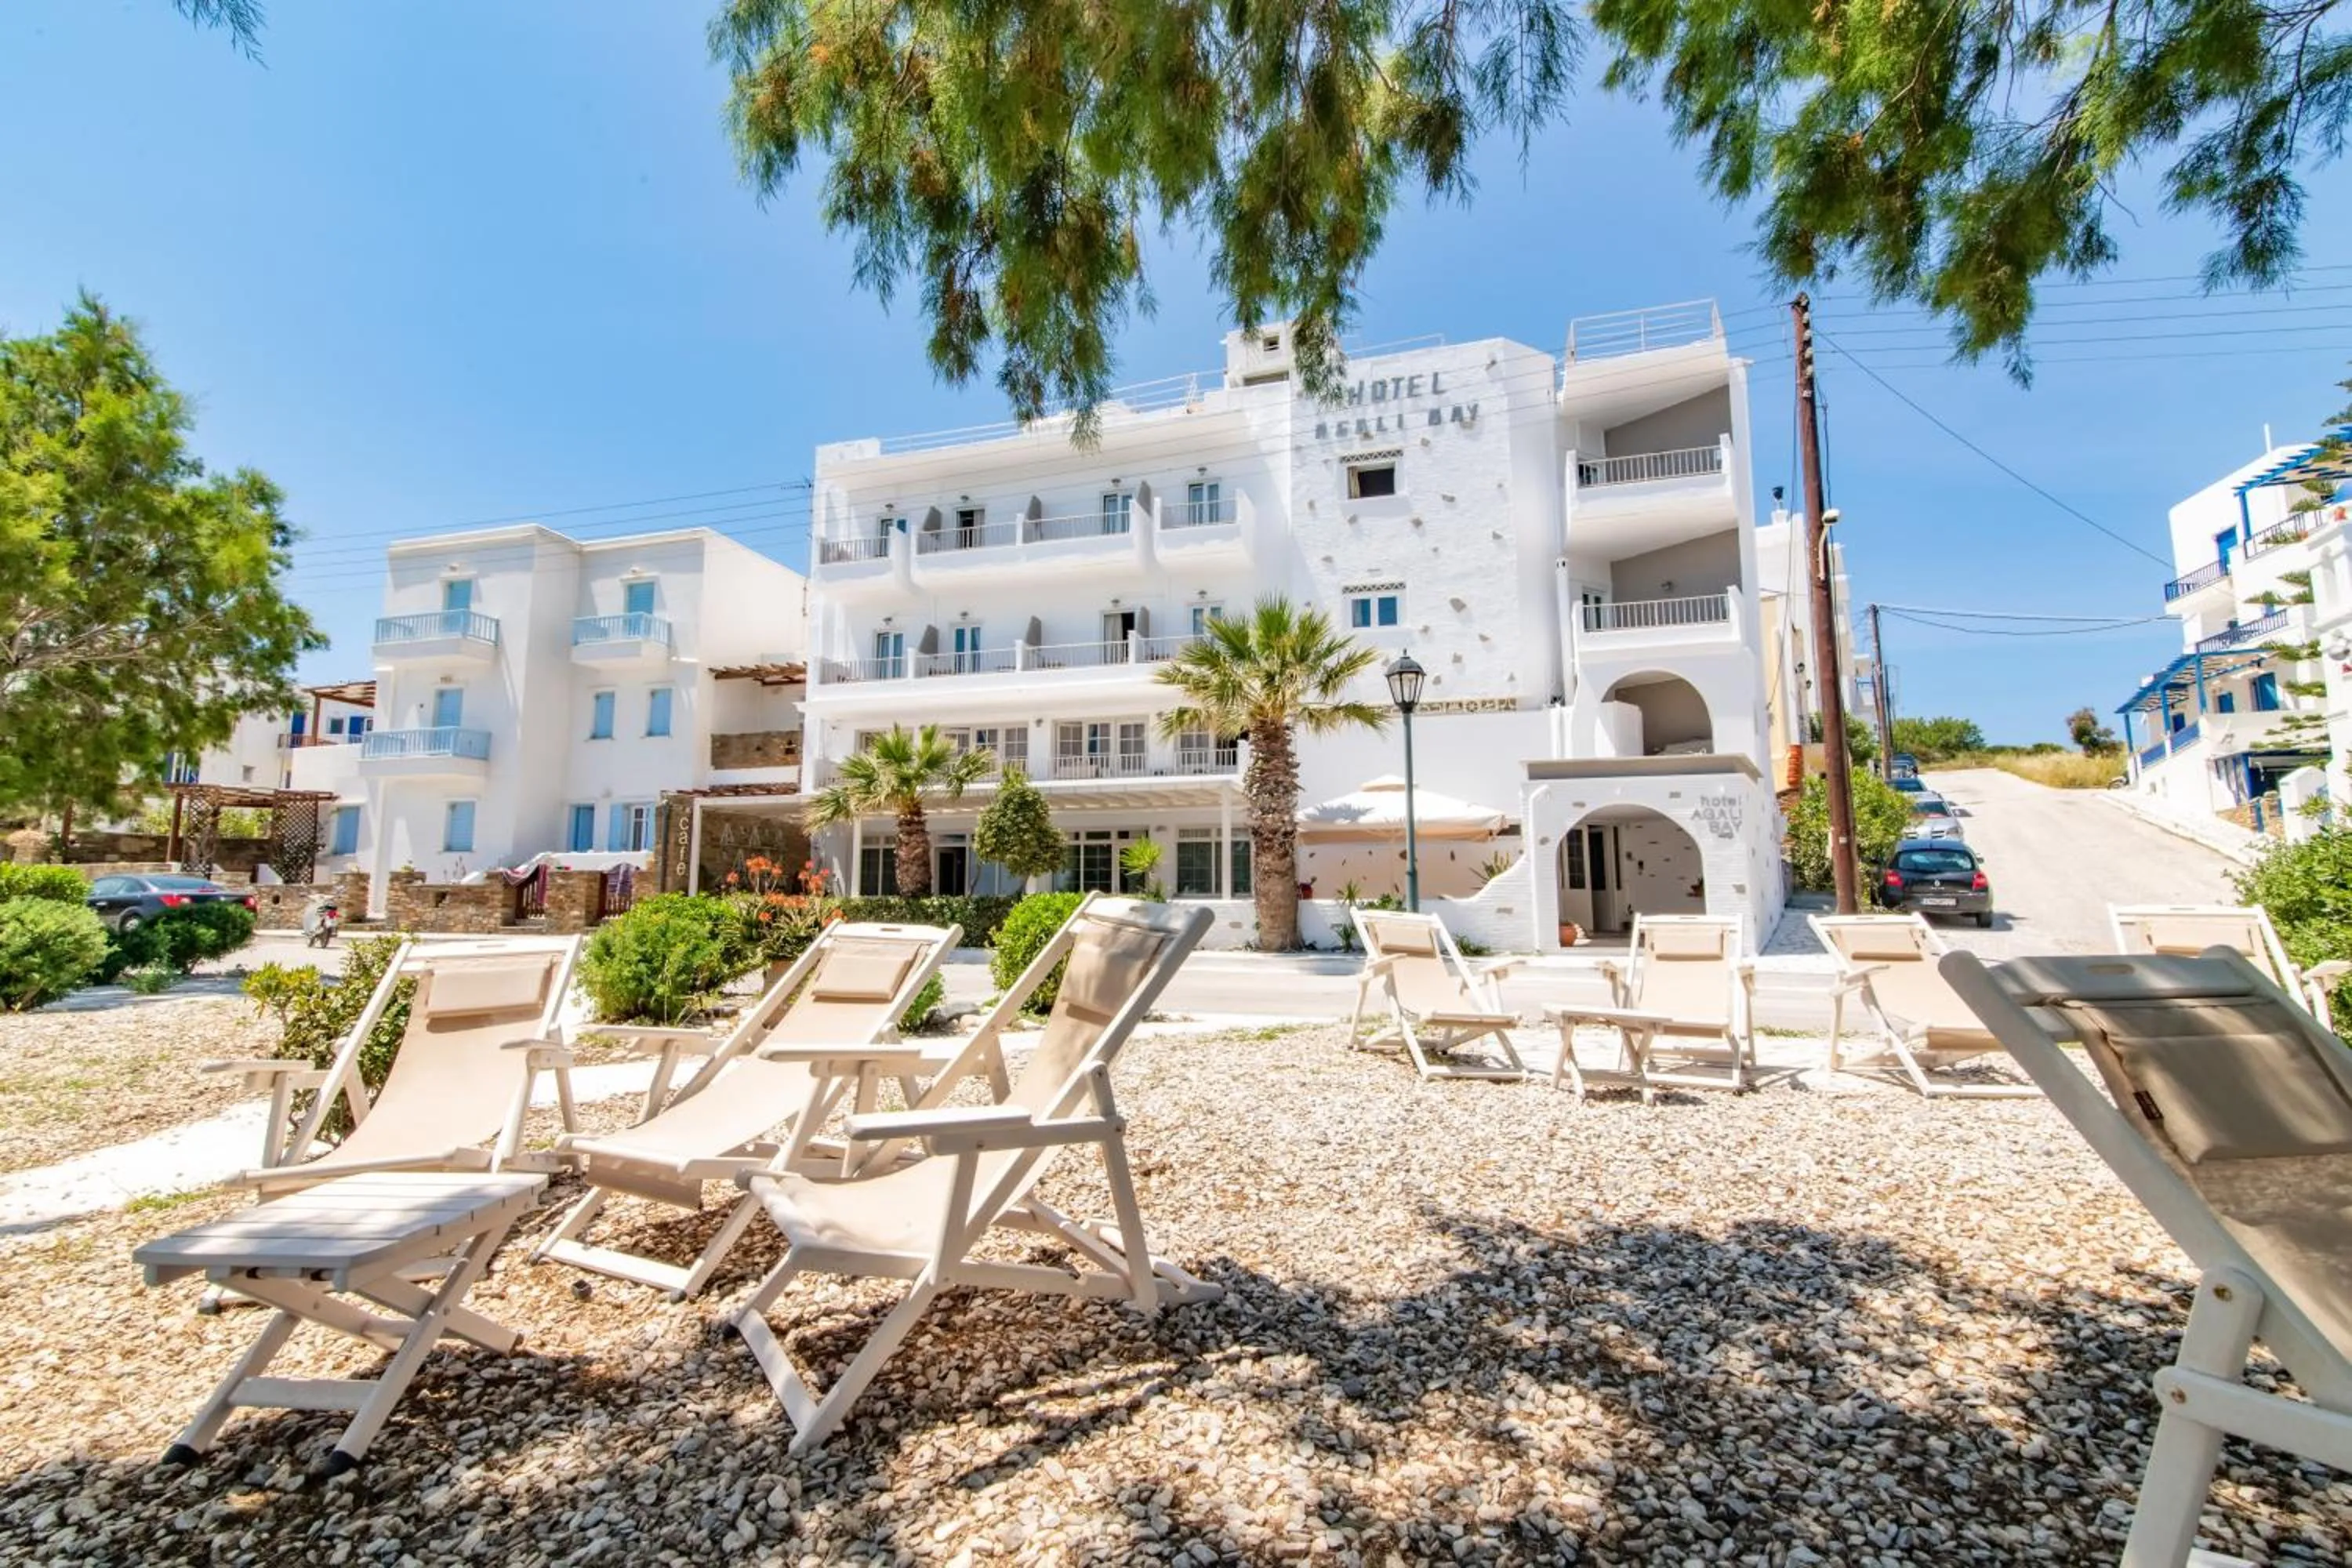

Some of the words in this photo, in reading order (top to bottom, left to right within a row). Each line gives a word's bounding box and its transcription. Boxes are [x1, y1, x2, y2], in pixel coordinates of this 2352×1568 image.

[1347, 372, 1446, 405] HOTEL
[1428, 403, 1479, 426] BAY
[1690, 808, 1742, 820] AGALI
[1709, 820, 1742, 833] BAY
